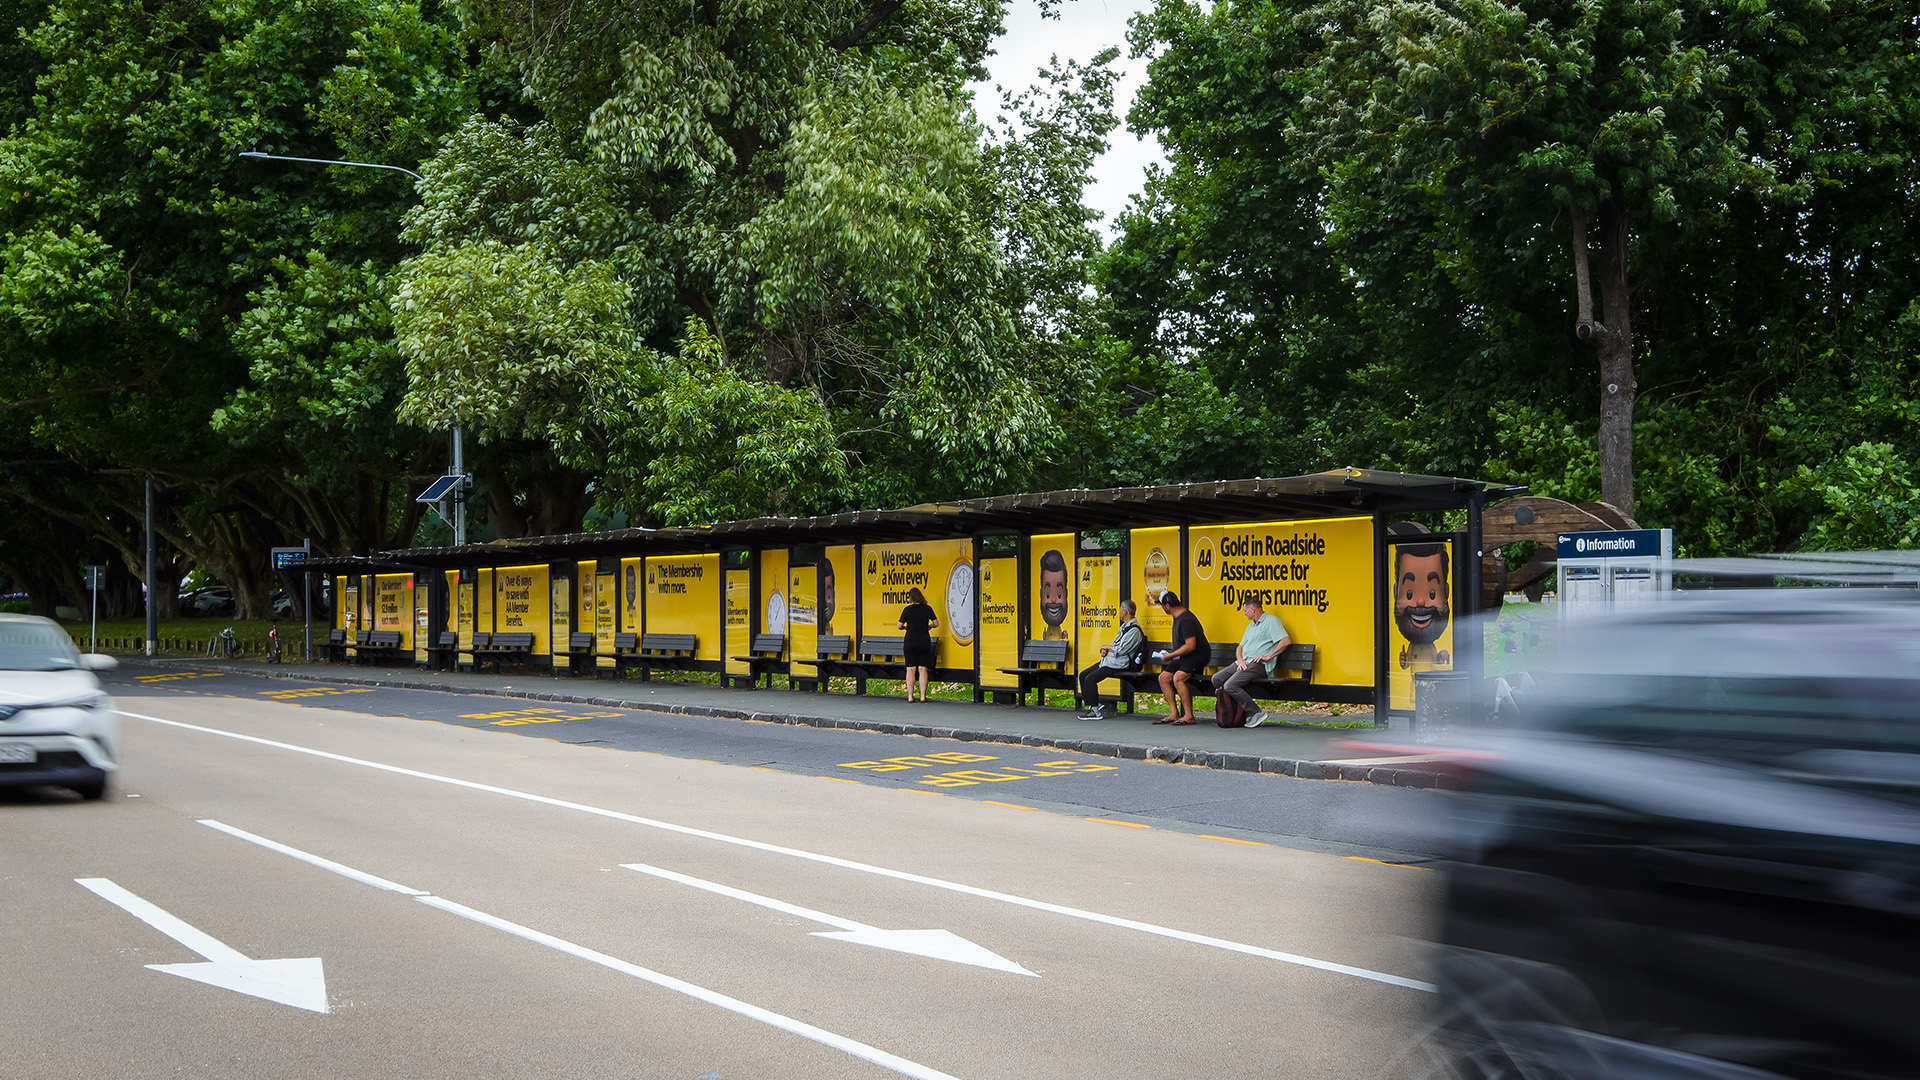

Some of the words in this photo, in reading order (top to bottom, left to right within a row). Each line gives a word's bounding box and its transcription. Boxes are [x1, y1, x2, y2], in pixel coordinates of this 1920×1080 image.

[1220, 535, 1248, 556] Gold
[1252, 534, 1262, 556] in
[1266, 533, 1325, 556] Roadside
[1586, 538, 1635, 550] Information
[882, 550, 894, 566] We
[896, 552, 922, 566] rescue
[1198, 549, 1212, 567] AA
[658, 565, 668, 578] The
[668, 563, 703, 581] Membership
[868, 560, 876, 574] AA
[1220, 559, 1288, 581] Assistance
[1290, 558, 1310, 580] for
[648, 573, 655, 584] AA
[882, 576, 886, 586] a
[888, 568, 904, 585] Kiwi
[906, 572, 928, 589] every
[984, 571, 991, 581] AA
[1082, 571, 1090, 581] AA
[506, 576, 515, 586] Over
[521, 576, 532, 590] ways
[658, 581, 670, 593] with
[671, 584, 687, 593] more.
[510, 591, 519, 600] save
[983, 593, 991, 603] The
[1081, 595, 1091, 605] The
[1221, 585, 1234, 605] 10
[1236, 589, 1272, 612] years
[1274, 584, 1330, 612] running.
[512, 602, 529, 613] Member
[983, 604, 1015, 616] Membership
[1081, 606, 1117, 618] Membership
[506, 615, 523, 626] Benefits.
[983, 614, 994, 624] with
[994, 616, 1010, 624] more.
[1081, 618, 1093, 628] with
[1095, 619, 1112, 628] more.
[836, 752, 1000, 772] BUS
[918, 760, 1118, 787] STOP
